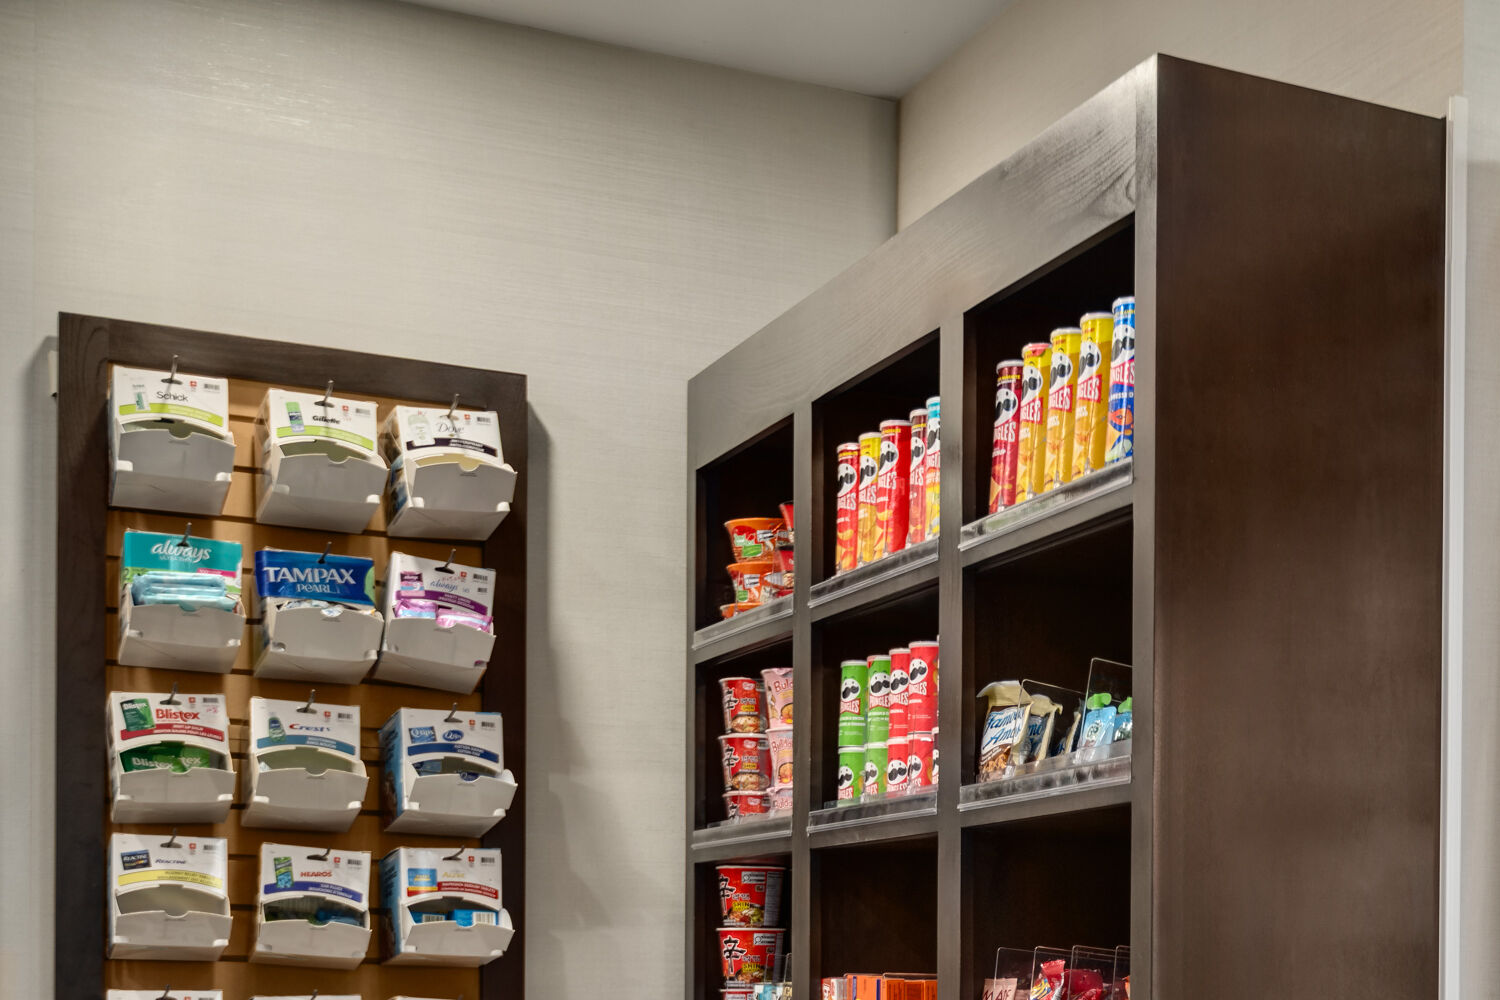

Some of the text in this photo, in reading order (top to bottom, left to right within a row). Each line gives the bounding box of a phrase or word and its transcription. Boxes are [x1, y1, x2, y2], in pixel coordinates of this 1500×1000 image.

[156, 391, 189, 402] Schick
[151, 540, 212, 563] always
[263, 566, 356, 585] TAMPAX
[155, 708, 200, 723] Blistex
[983, 726, 1022, 750] Amos
